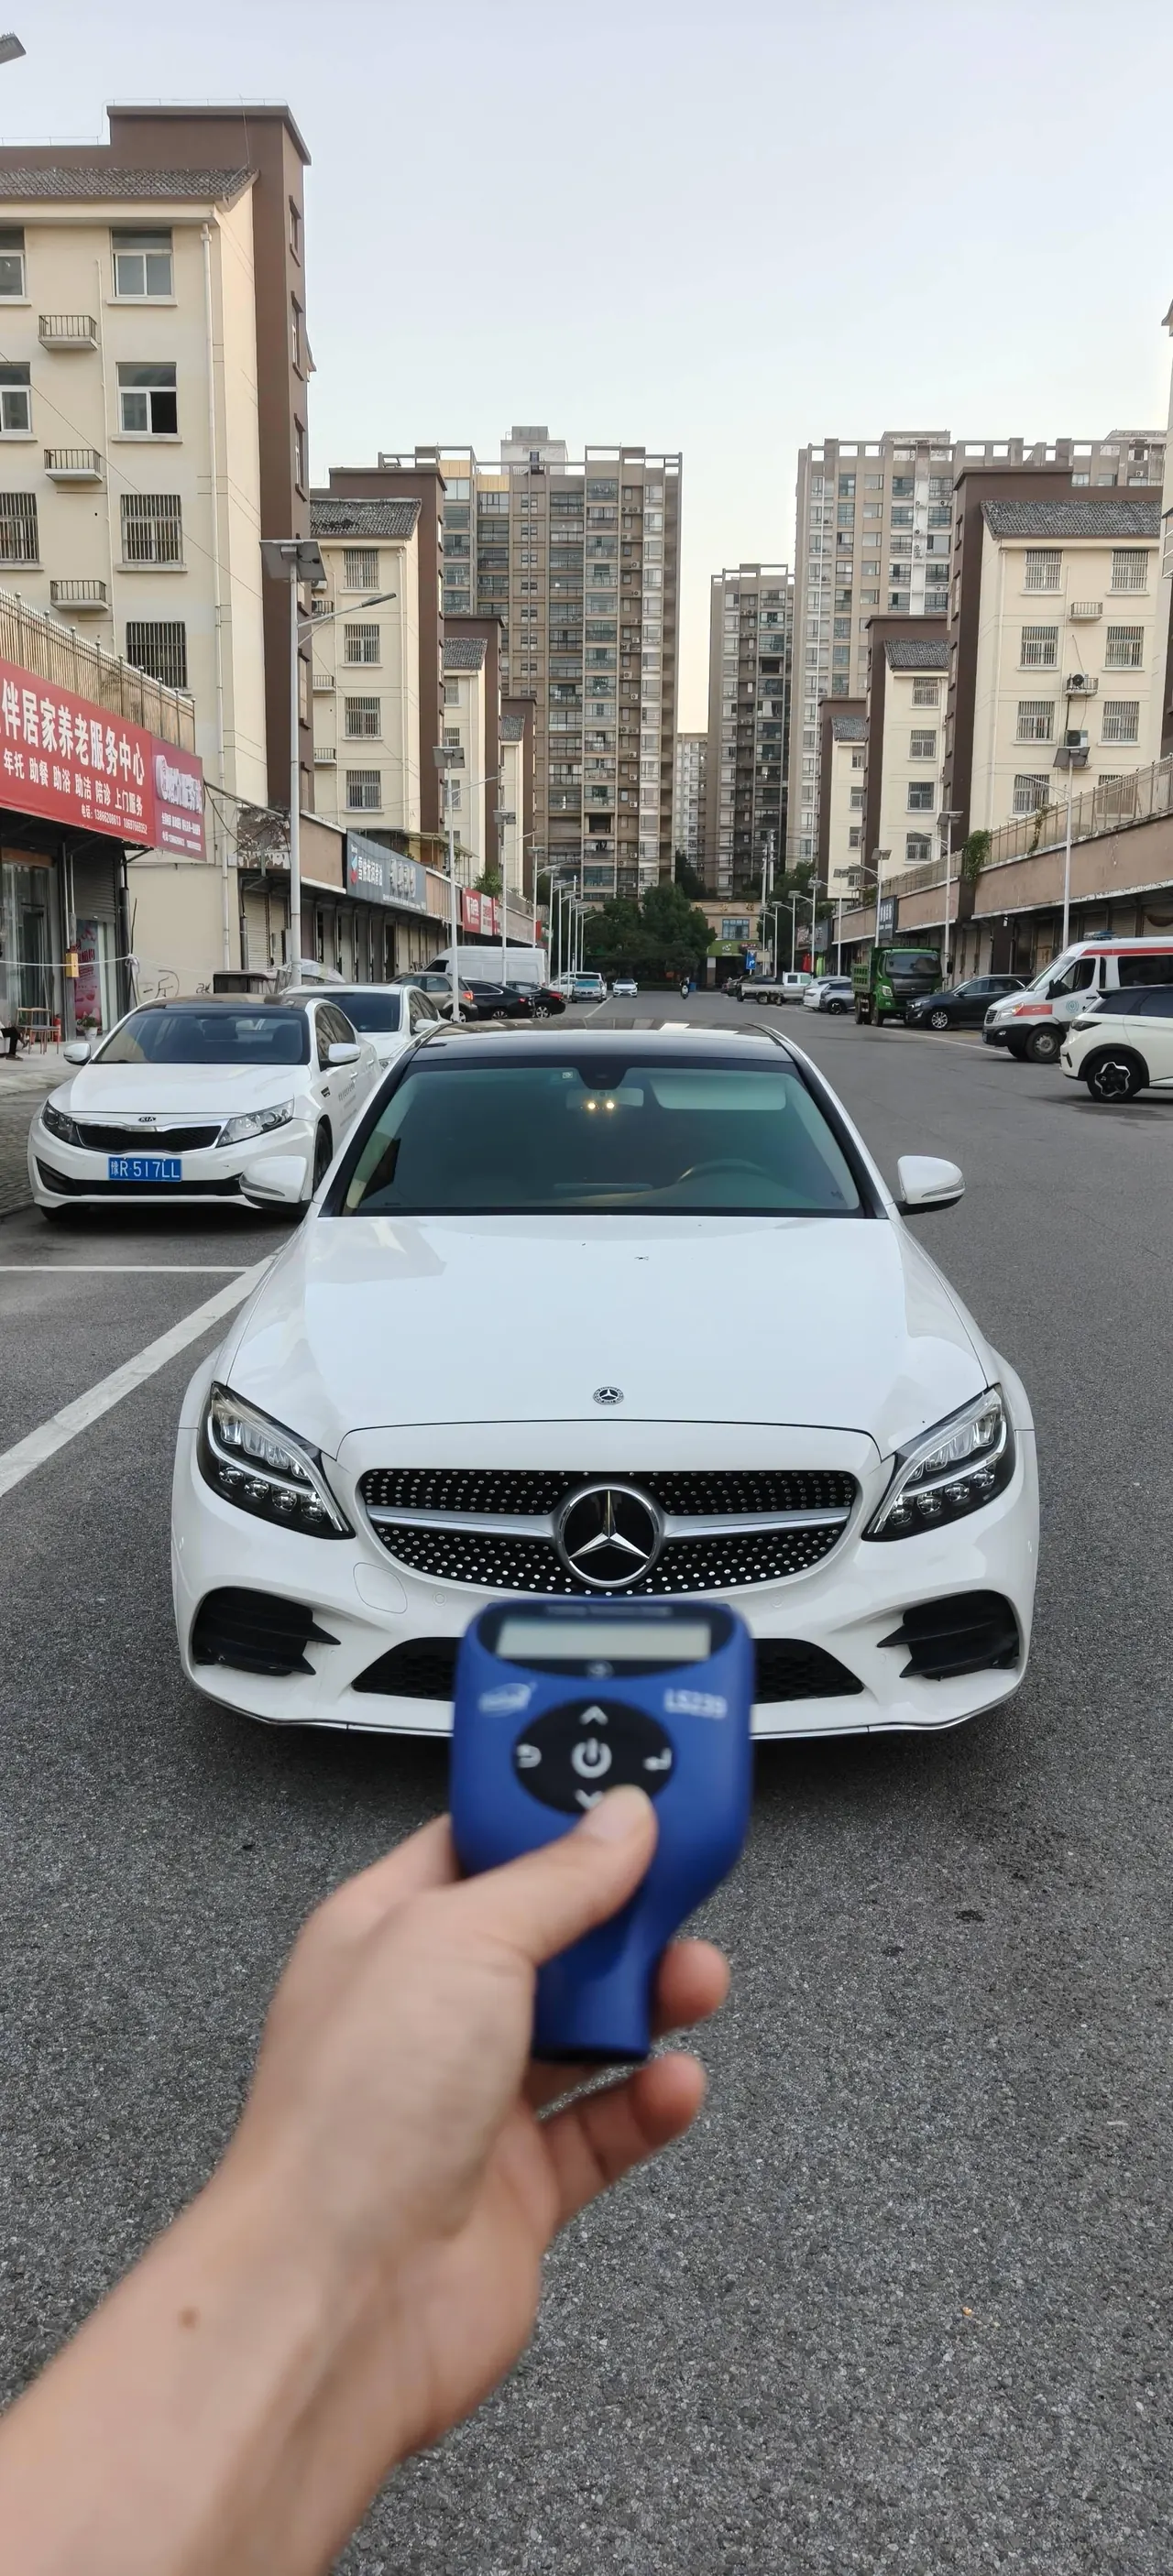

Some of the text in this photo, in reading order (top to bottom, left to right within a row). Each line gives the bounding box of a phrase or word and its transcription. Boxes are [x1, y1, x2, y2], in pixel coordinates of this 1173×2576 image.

[2, 678, 144, 786] 伴居家养老服务中心
[4, 748, 25, 780] 年托
[29, 757, 49, 788] 助餐
[53, 765, 71, 794] 助浴
[75, 773, 92, 800] 助洁
[115, 788, 143, 817] 上门服务
